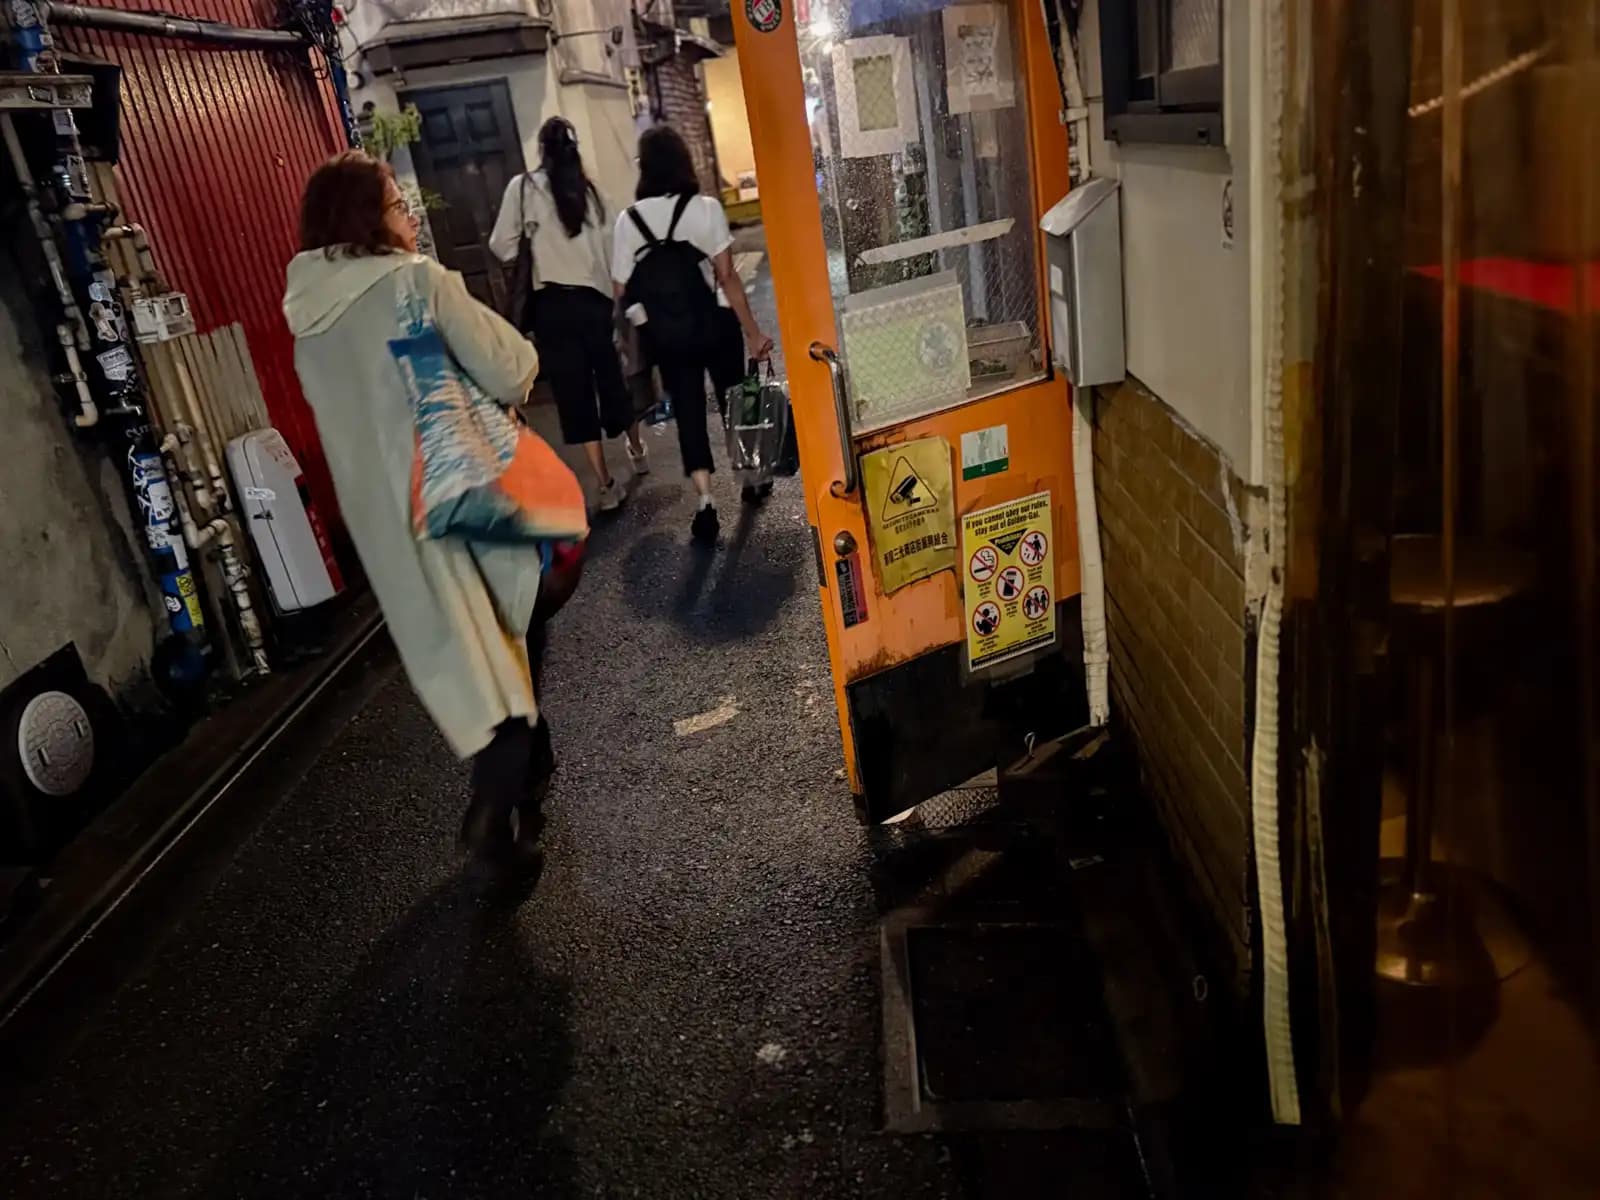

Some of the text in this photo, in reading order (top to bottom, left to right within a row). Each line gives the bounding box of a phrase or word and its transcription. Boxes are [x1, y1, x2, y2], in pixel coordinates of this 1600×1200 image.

[972, 519, 983, 529] you
[984, 512, 1005, 525] cannot
[1006, 509, 1020, 518] obey
[975, 528, 988, 537] stay
[988, 523, 999, 533] out
